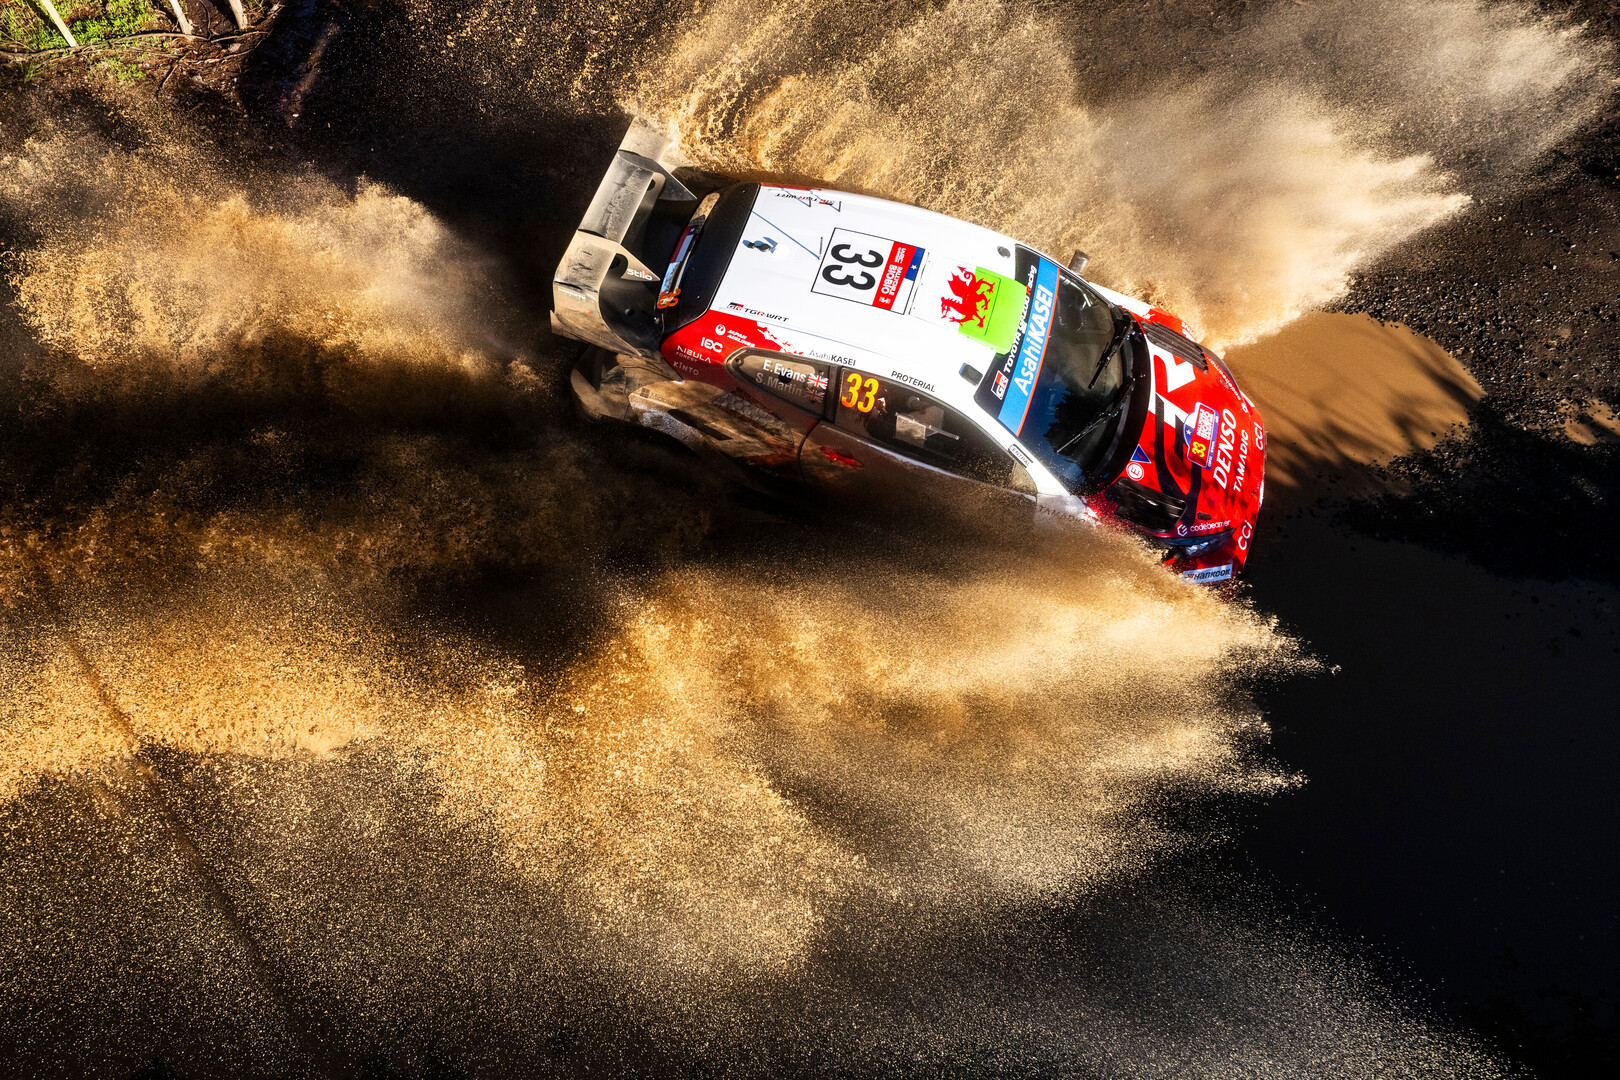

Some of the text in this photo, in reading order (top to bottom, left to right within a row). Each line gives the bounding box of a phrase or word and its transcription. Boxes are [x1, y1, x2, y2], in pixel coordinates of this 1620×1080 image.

[626, 268, 653, 280] stilo
[822, 243, 884, 291] 33
[727, 329, 747, 340] JAPAN
[727, 334, 756, 348] AIRLINES
[996, 376, 1009, 401] GR
[1003, 328, 1021, 374] TOYOTA
[1025, 265, 1038, 296] Racing
[1013, 283, 1054, 397] AsahiKASEI
[809, 349, 857, 367] AsahiKASEI
[840, 372, 880, 414] 33
[891, 370, 936, 393] PROTERIAL
[1191, 441, 1206, 458] 33
[1213, 408, 1237, 490] DENSO
[1233, 430, 1249, 493] TAMADIC
[1190, 520, 1231, 533] codebeamer
